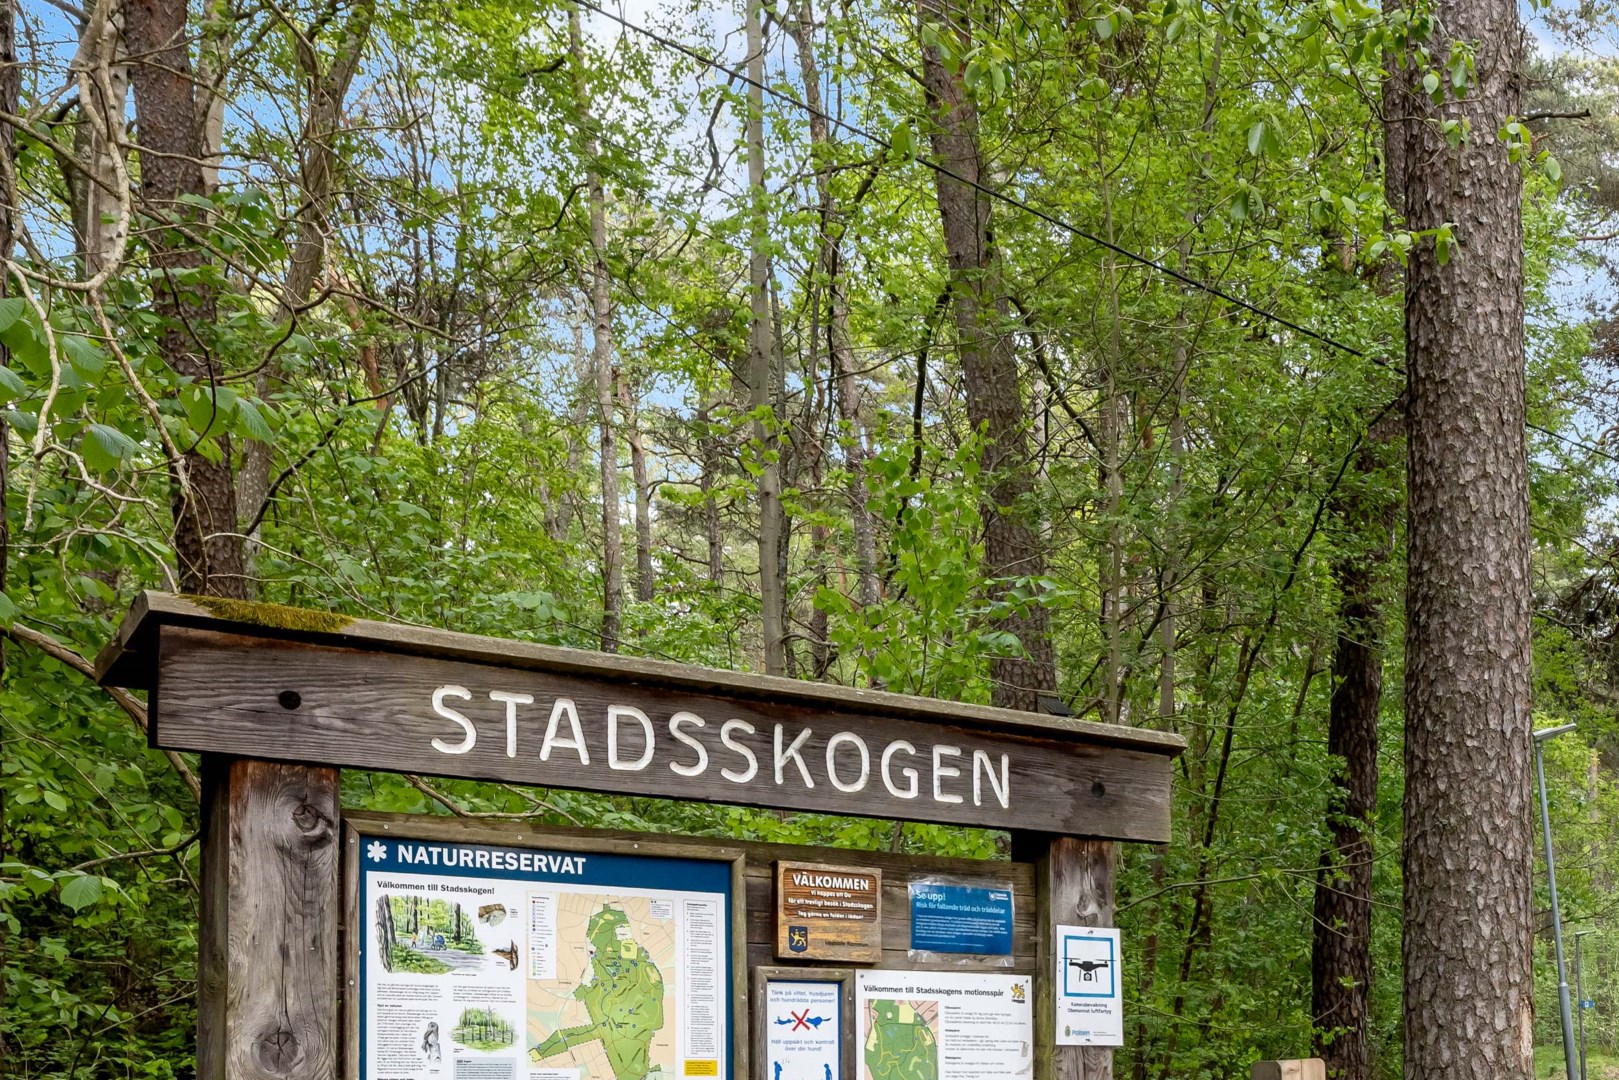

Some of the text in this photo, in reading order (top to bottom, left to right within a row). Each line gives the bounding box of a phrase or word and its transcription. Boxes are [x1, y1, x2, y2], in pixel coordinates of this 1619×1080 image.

[430, 684, 1010, 808] STADSSKOGEN
[398, 844, 586, 875] NATURRESERVAT
[376, 880, 494, 895] Välkommen till Stadsskogen!
[792, 872, 869, 890] VÄLKOMMEN
[916, 891, 946, 902] Se upp!
[864, 985, 903, 993] Välkommen
[916, 987, 963, 996] Stadsskogens
[965, 988, 1004, 997] motionsspår
